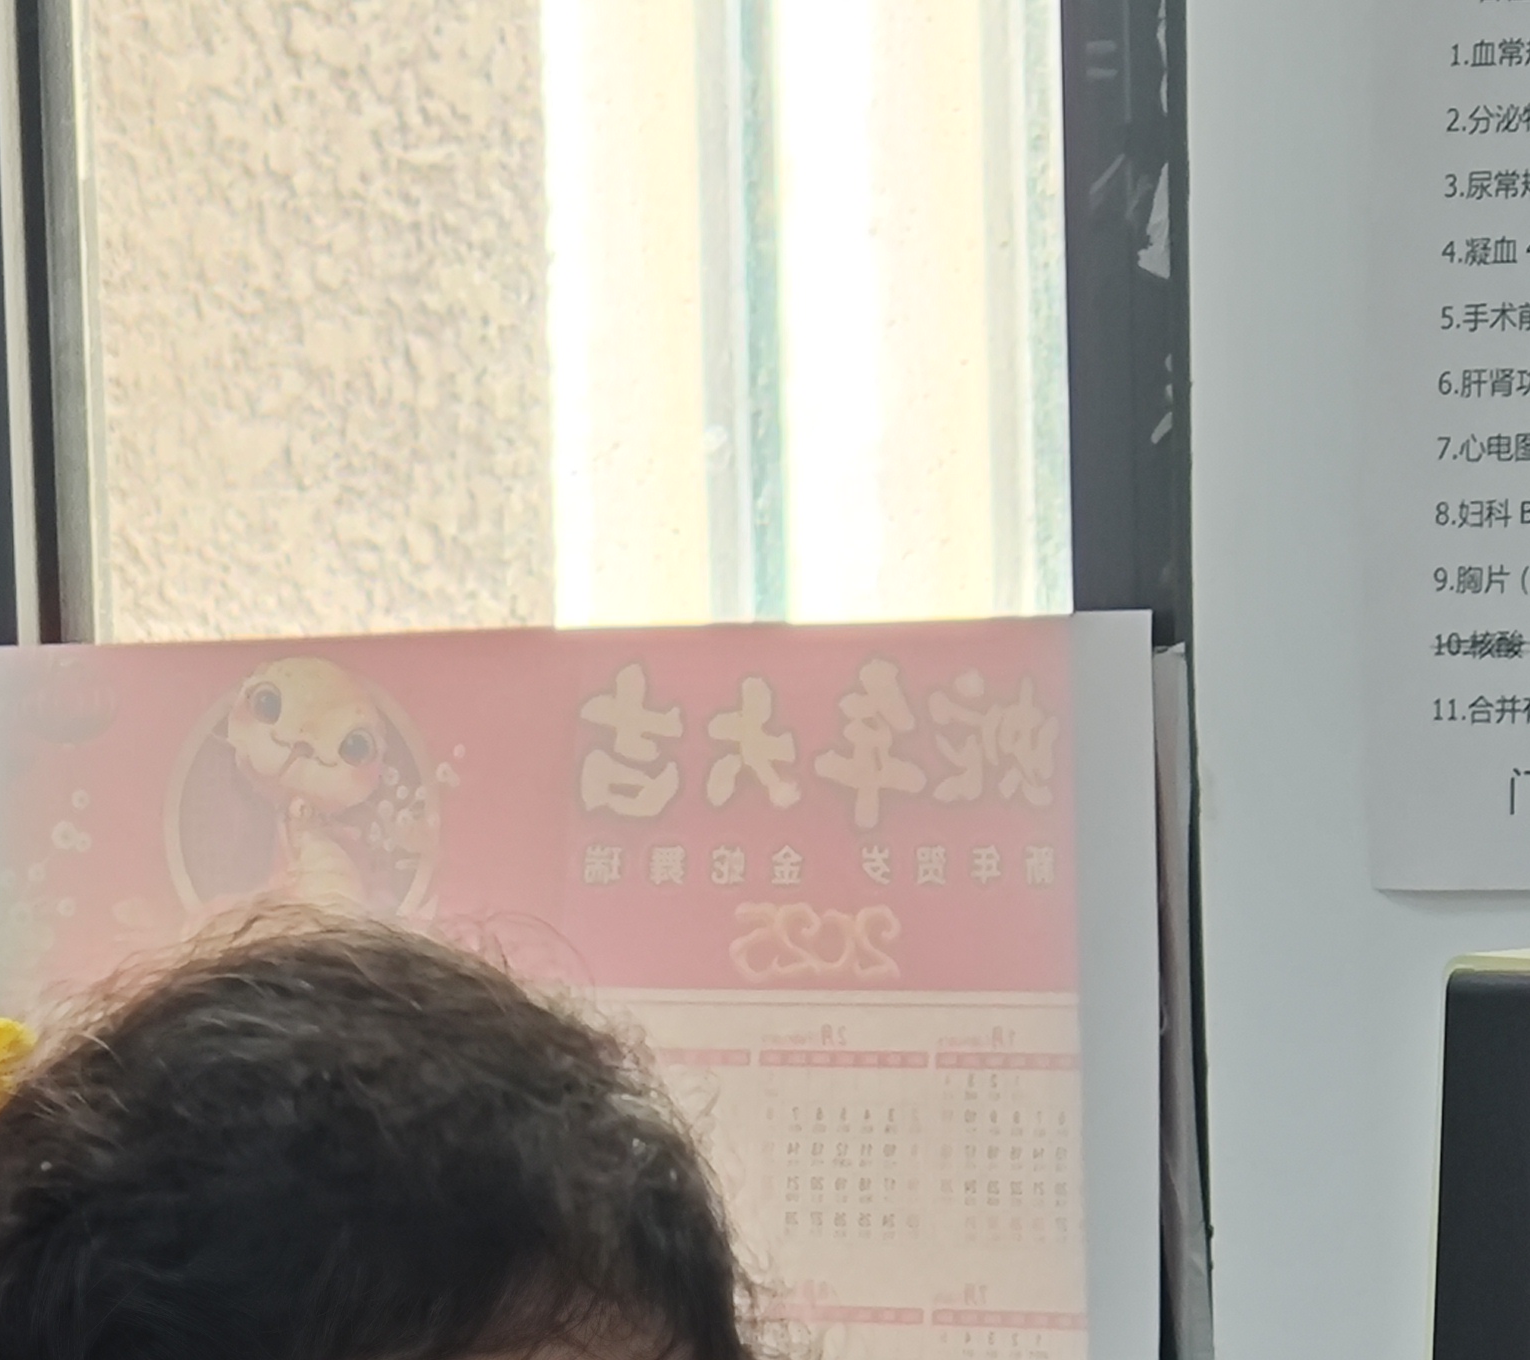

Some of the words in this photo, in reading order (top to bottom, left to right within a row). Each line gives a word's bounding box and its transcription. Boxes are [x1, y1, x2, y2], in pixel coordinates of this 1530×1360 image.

[1451, 37, 1530, 67] 1.血常
[1441, 236, 1517, 266] 4.凝血
[1433, 695, 1530, 724] 11.合并
